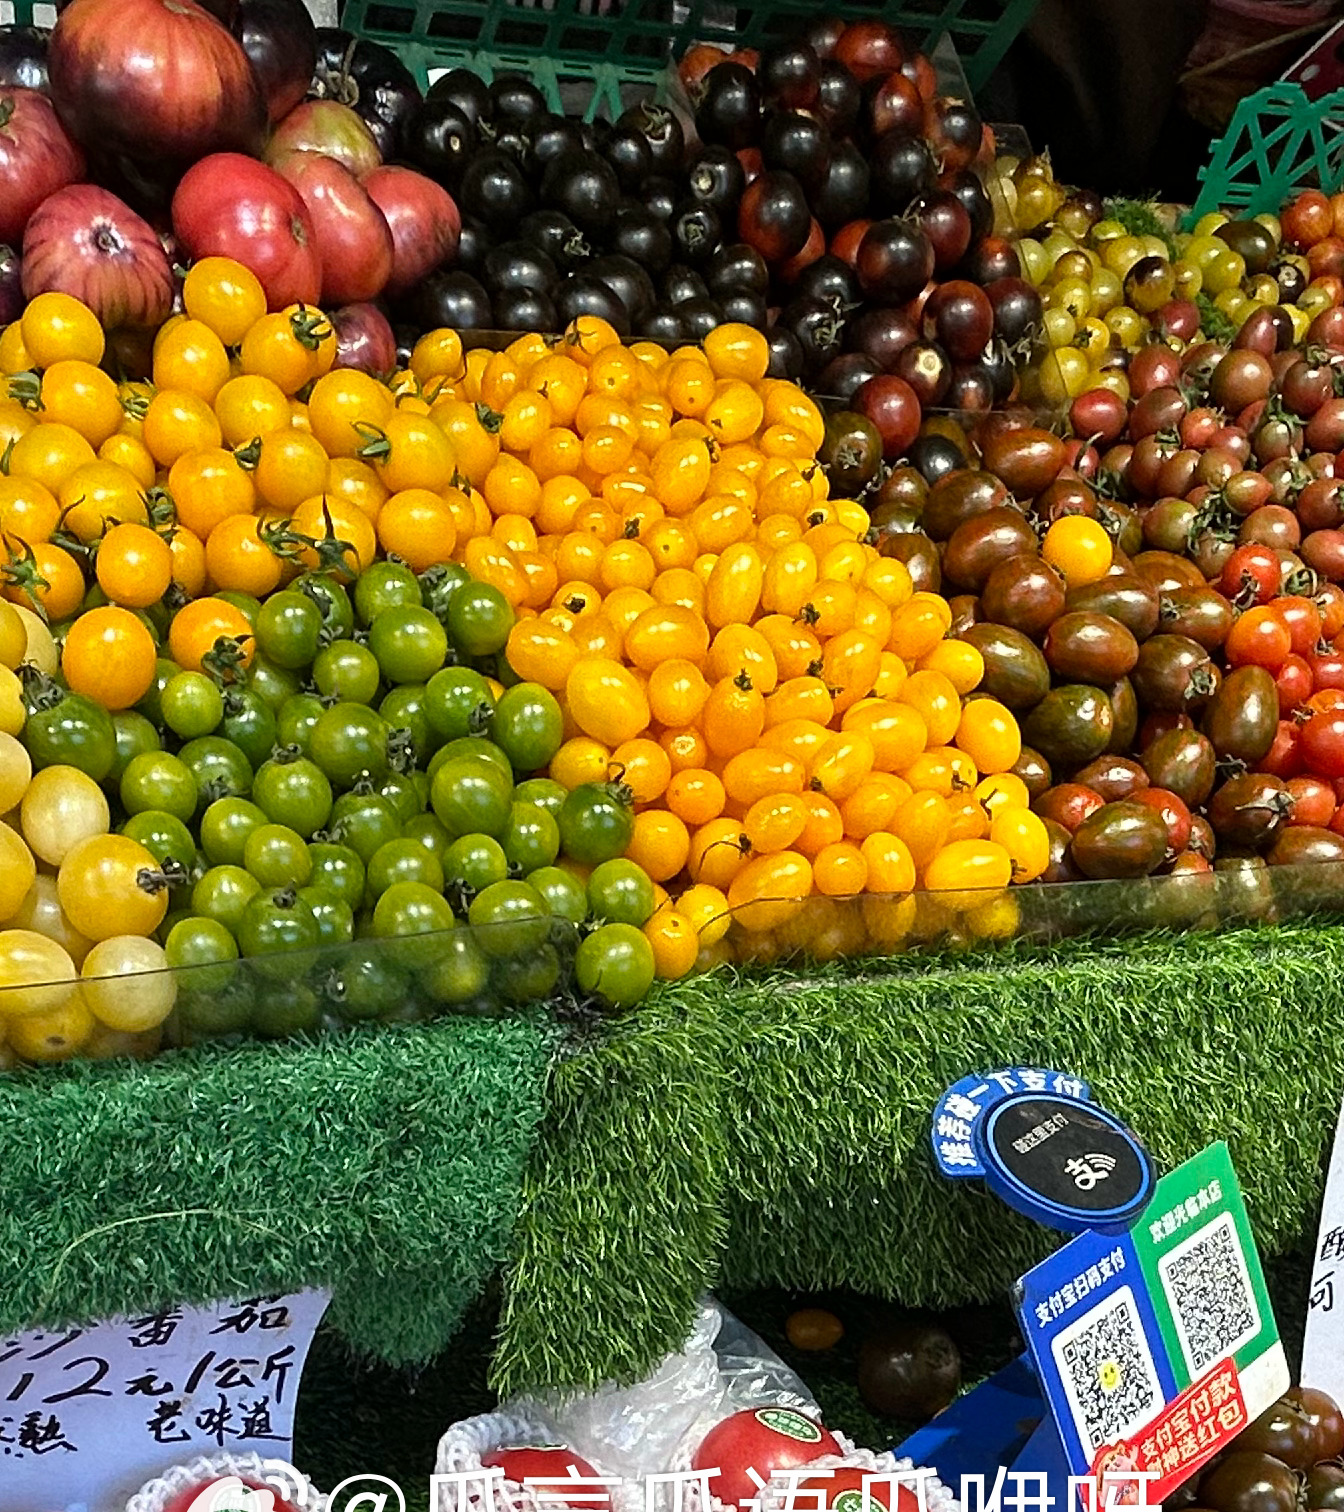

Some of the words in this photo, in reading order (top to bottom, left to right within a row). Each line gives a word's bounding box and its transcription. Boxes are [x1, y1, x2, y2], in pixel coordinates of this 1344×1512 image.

[6, 1346, 295, 1404] 12元/公斤
[147, 1393, 293, 1447] 老味道
[1140, 1371, 1237, 1463] 支付宝付款
